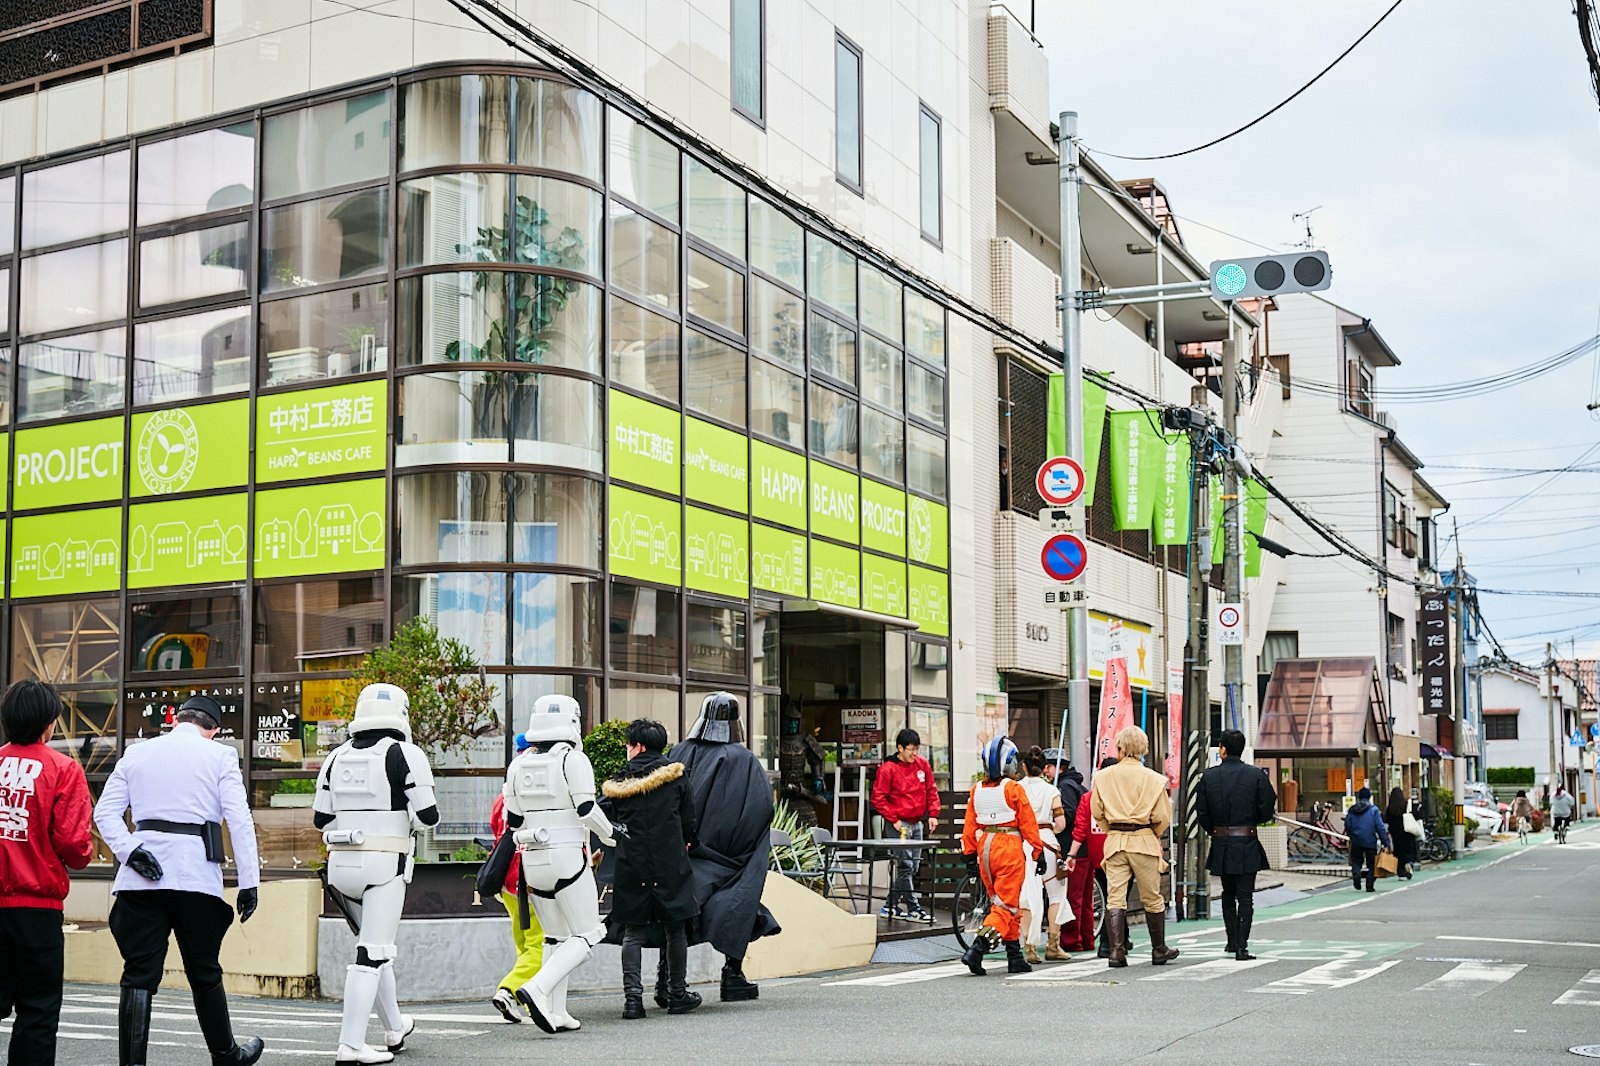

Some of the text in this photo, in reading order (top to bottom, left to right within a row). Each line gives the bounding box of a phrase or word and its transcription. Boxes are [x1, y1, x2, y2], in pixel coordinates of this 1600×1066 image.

[269, 395, 374, 434] 中村工務店
[146, 410, 185, 435] HAPPY
[180, 424, 197, 481] BEANS
[308, 449, 343, 465] BEANS
[345, 445, 372, 461] CAFE
[615, 421, 674, 465] 中村工務店
[17, 441, 122, 487] PROJECT
[709, 458, 731, 477] BEANS
[730, 465, 746, 482] CAFE
[760, 465, 805, 508] HAPPY
[813, 482, 856, 524] BEANS
[861, 498, 906, 538] PROJECT
[1045, 590, 1084, 603] 自動車
[1223, 612, 1235, 623] 30
[1425, 600, 1445, 667] ぶつだん
[127, 684, 302, 700] HAPPY BEANS CAFE
[257, 730, 291, 744] BEANS
[257, 745, 282, 758] CAFE
